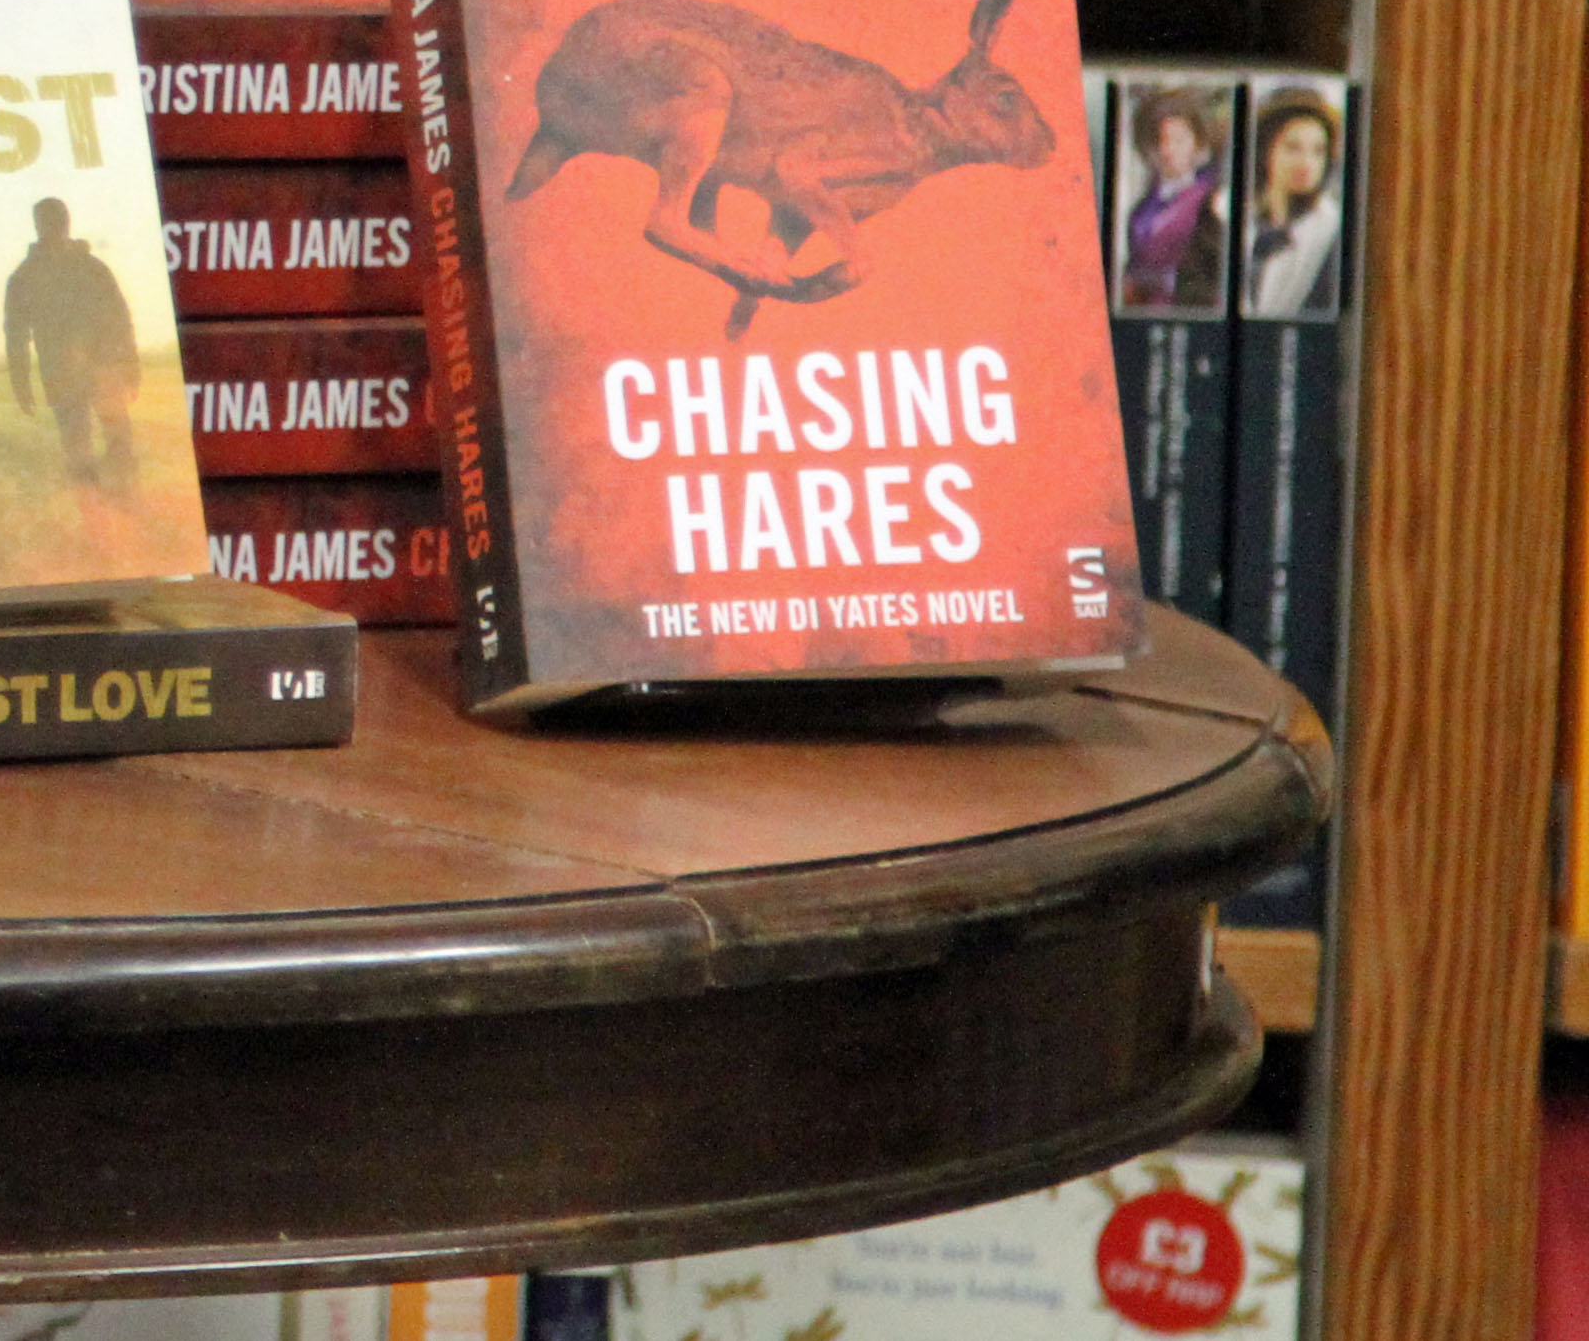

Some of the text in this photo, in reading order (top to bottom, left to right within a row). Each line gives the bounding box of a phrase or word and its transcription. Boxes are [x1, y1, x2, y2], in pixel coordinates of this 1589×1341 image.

[413, 28, 452, 176] JAMES
[283, 217, 412, 270] JAMES
[430, 185, 475, 394] CHASING
[281, 378, 411, 432] JAMES
[602, 345, 1017, 461] CHASING
[454, 405, 492, 561] HARES
[666, 462, 982, 575] HARES
[268, 528, 397, 583] JAMES
[642, 588, 1025, 639] THE NEW DI YATES NOVEL
[1074, 599, 1109, 620] SALT
[60, 666, 214, 721] LOVE
